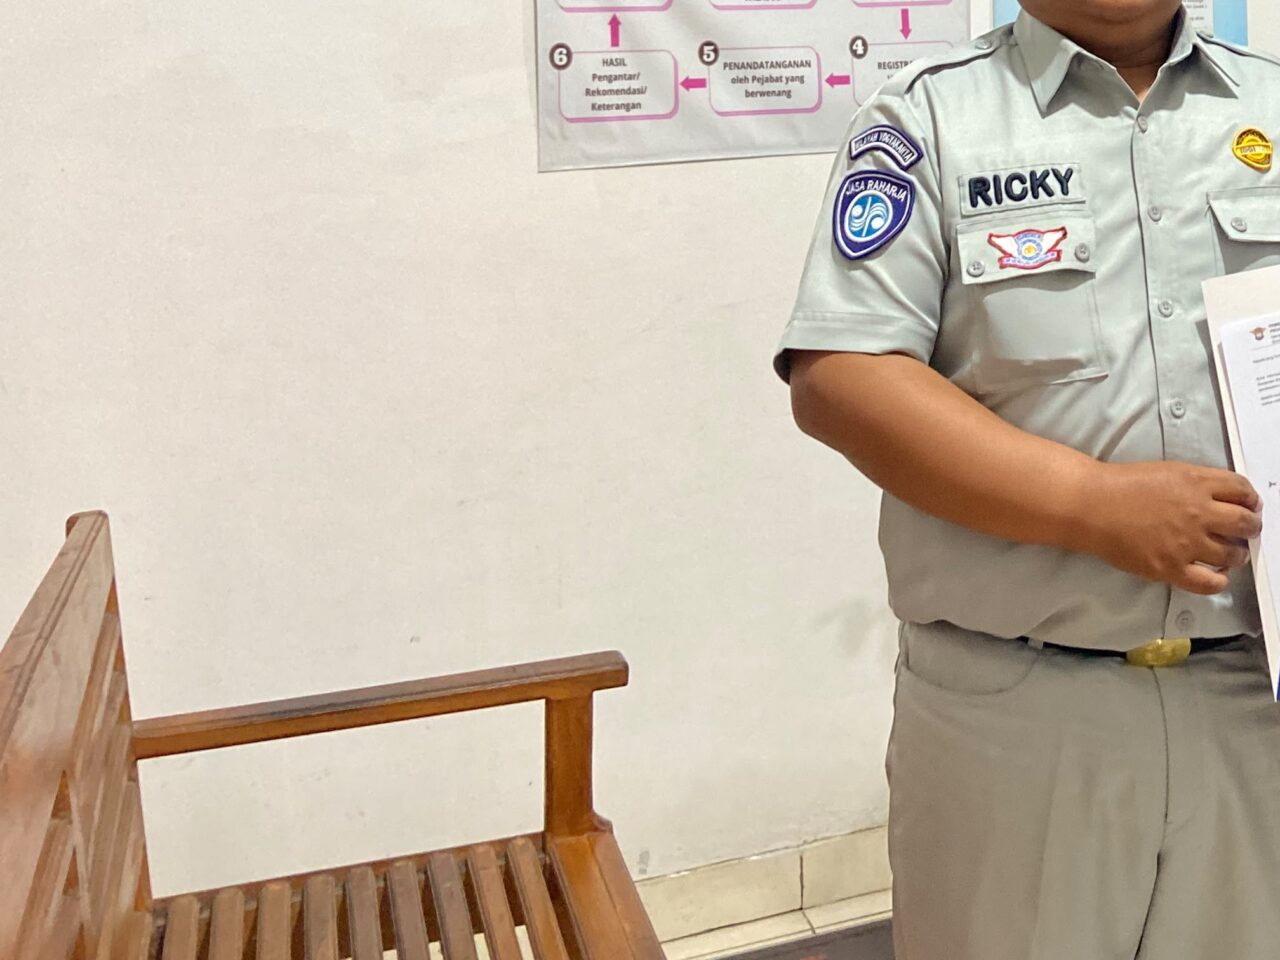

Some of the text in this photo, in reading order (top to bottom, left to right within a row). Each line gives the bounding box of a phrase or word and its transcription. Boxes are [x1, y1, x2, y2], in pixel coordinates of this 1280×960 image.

[852, 40, 864, 55] 4
[554, 48, 568, 66] 6
[703, 46, 715, 61] 5
[602, 58, 627, 67] HASIL
[723, 60, 811, 70] PENANDATANGANAN
[877, 61, 913, 70] REGISTR
[592, 72, 640, 83] Pengantar/
[731, 75, 804, 85] oleh Pejabat yang
[585, 86, 647, 96] Rekomendasi/
[745, 89, 792, 99] berwenang
[591, 101, 641, 112] Keterangan
[879, 132, 914, 162] YOGYAKARTA
[846, 180, 907, 202] JASA RAHARJA
[968, 168, 1073, 208] RICKY
